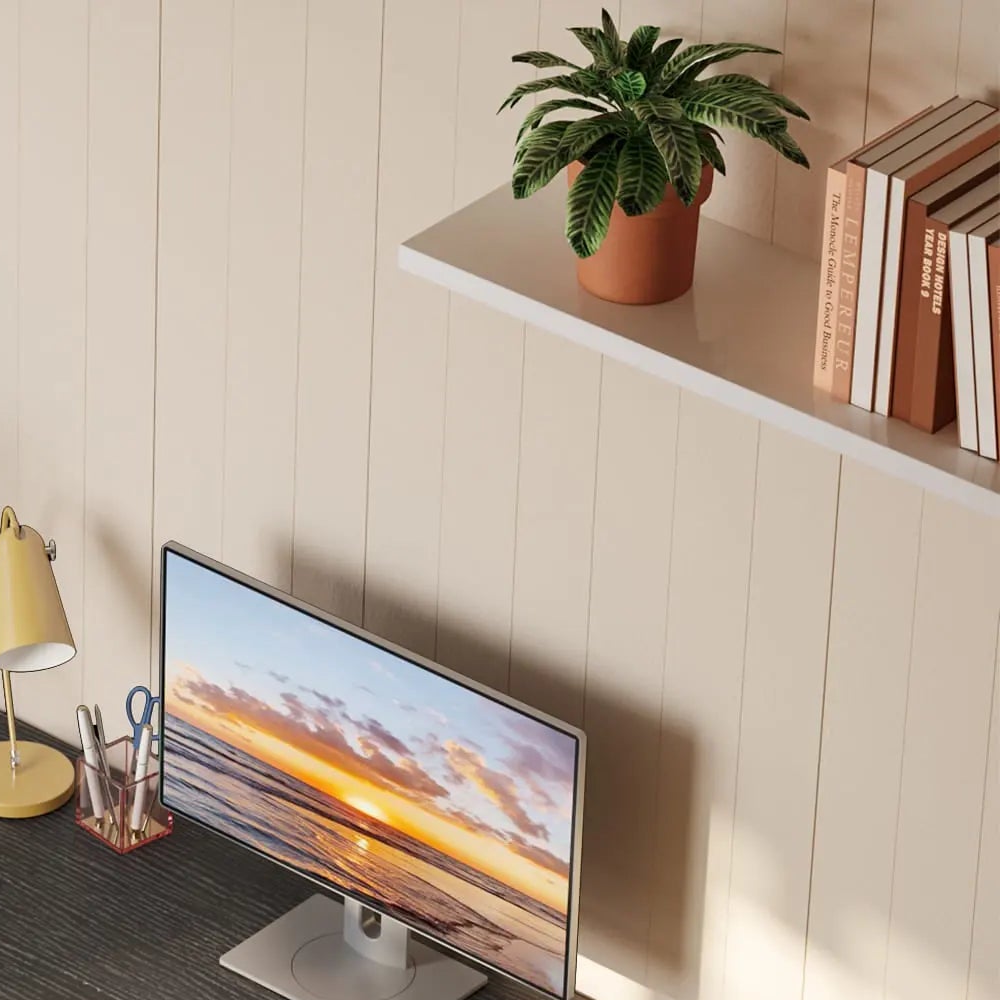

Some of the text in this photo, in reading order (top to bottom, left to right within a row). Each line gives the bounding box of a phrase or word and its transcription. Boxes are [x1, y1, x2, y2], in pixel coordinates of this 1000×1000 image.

[820, 193, 841, 371] The Monocle Guide to Good Business
[835, 217, 859, 373] LEMPEREUR
[920, 228, 935, 298] YEAR BOOK 9
[931, 232, 947, 315] DESIGN HOTELS
